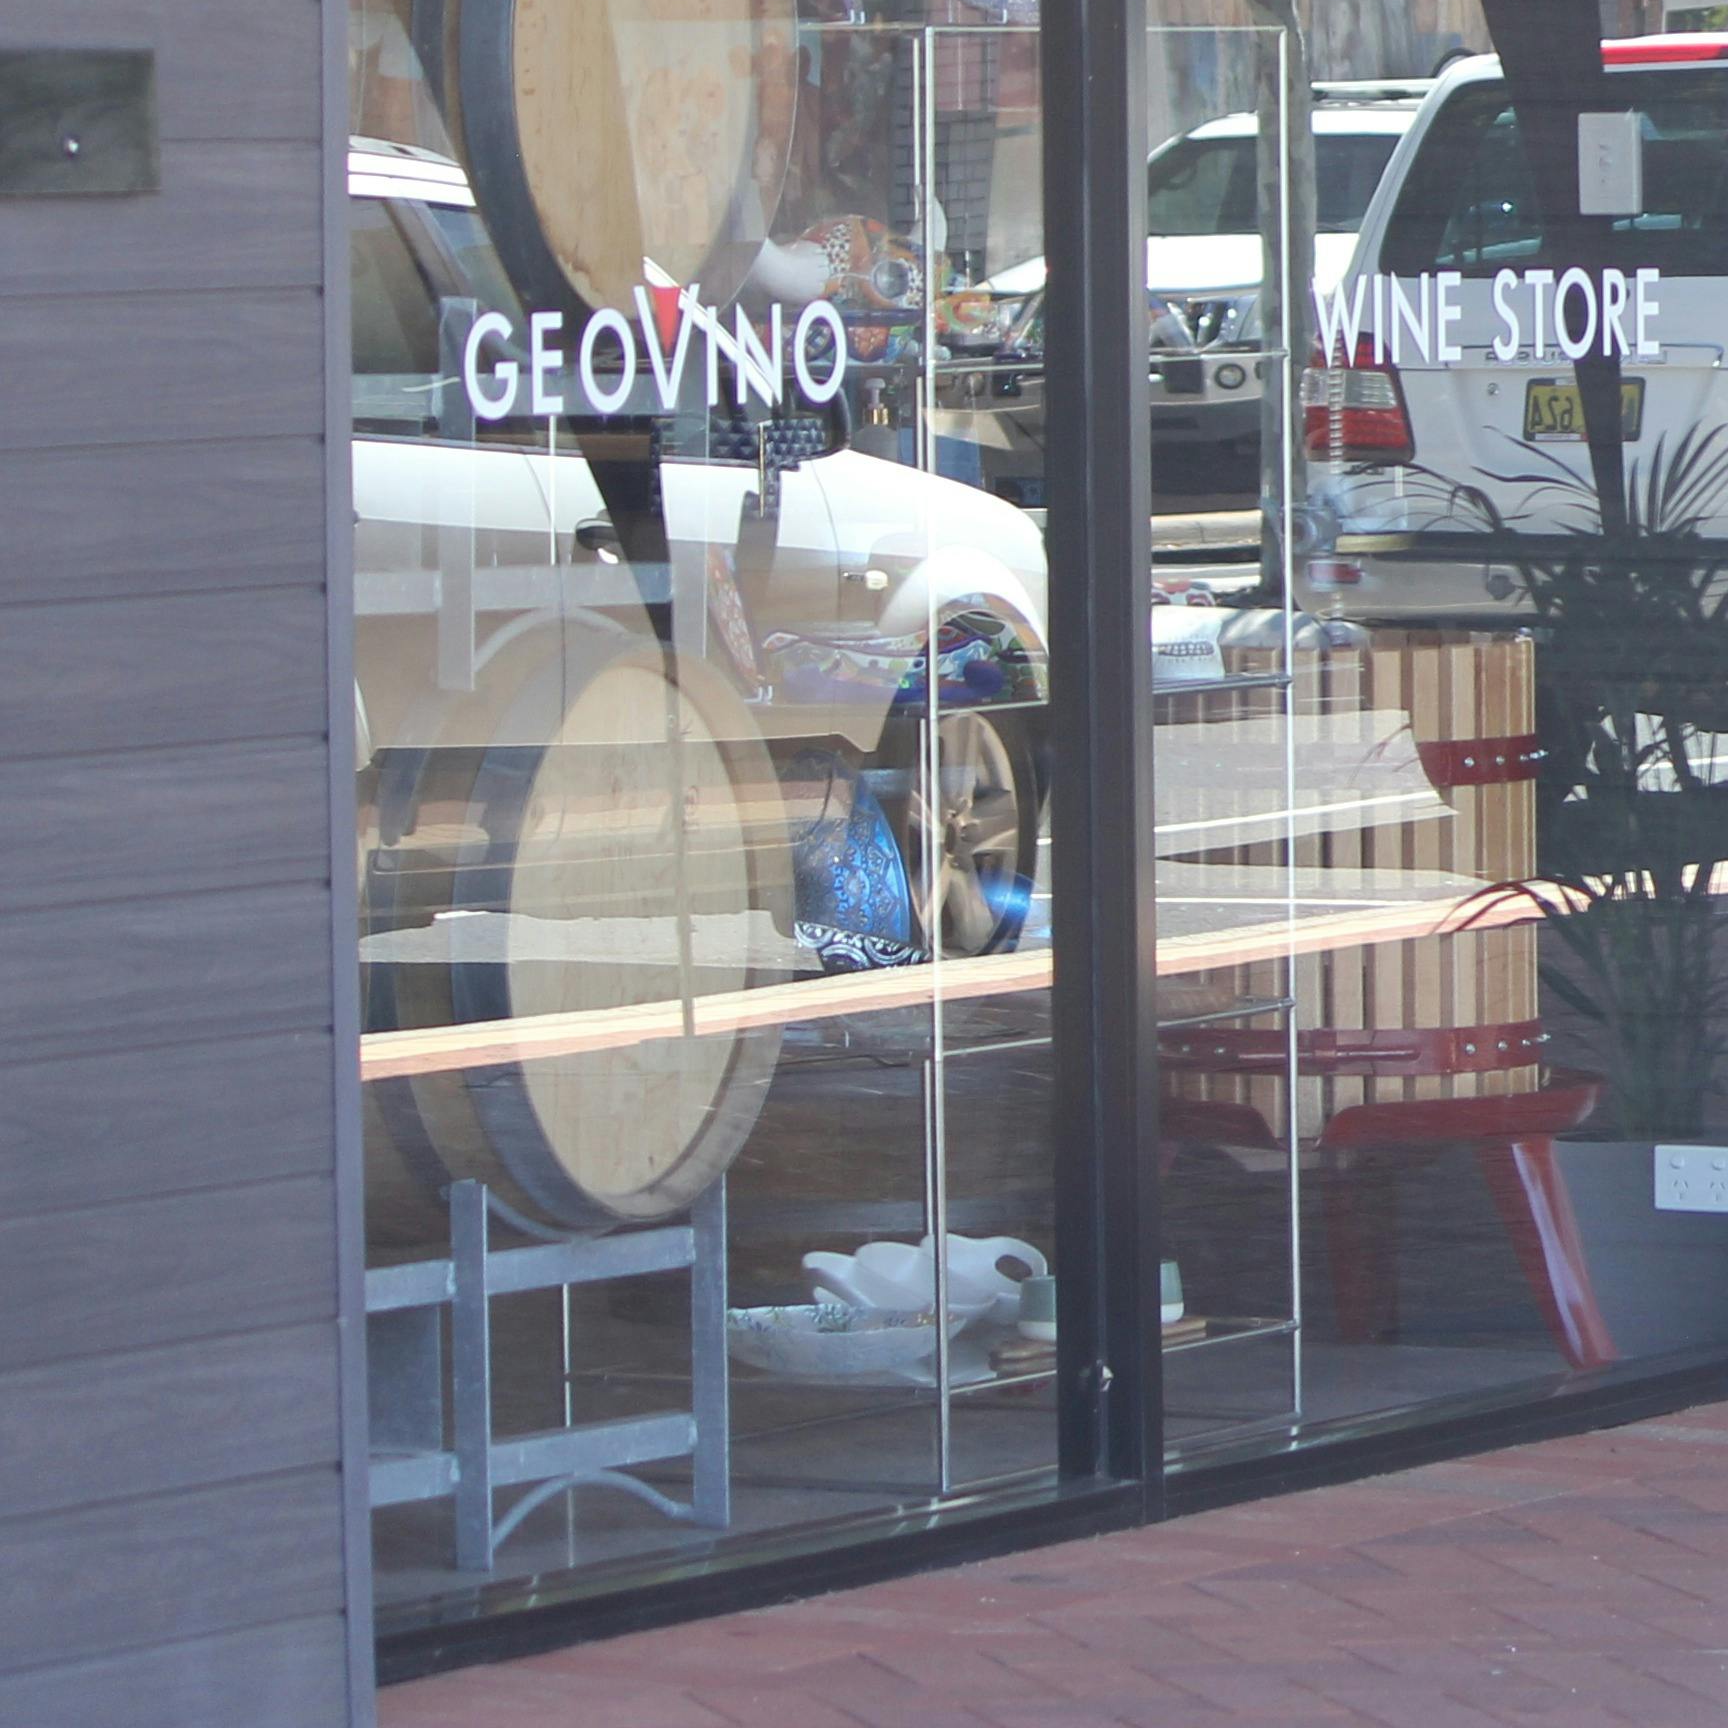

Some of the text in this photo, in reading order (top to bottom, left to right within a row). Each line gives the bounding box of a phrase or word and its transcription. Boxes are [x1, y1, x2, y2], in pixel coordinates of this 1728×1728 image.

[464, 282, 848, 421] GEOVINO
[1311, 270, 1462, 370] WINE
[1492, 266, 1661, 362] STORE
